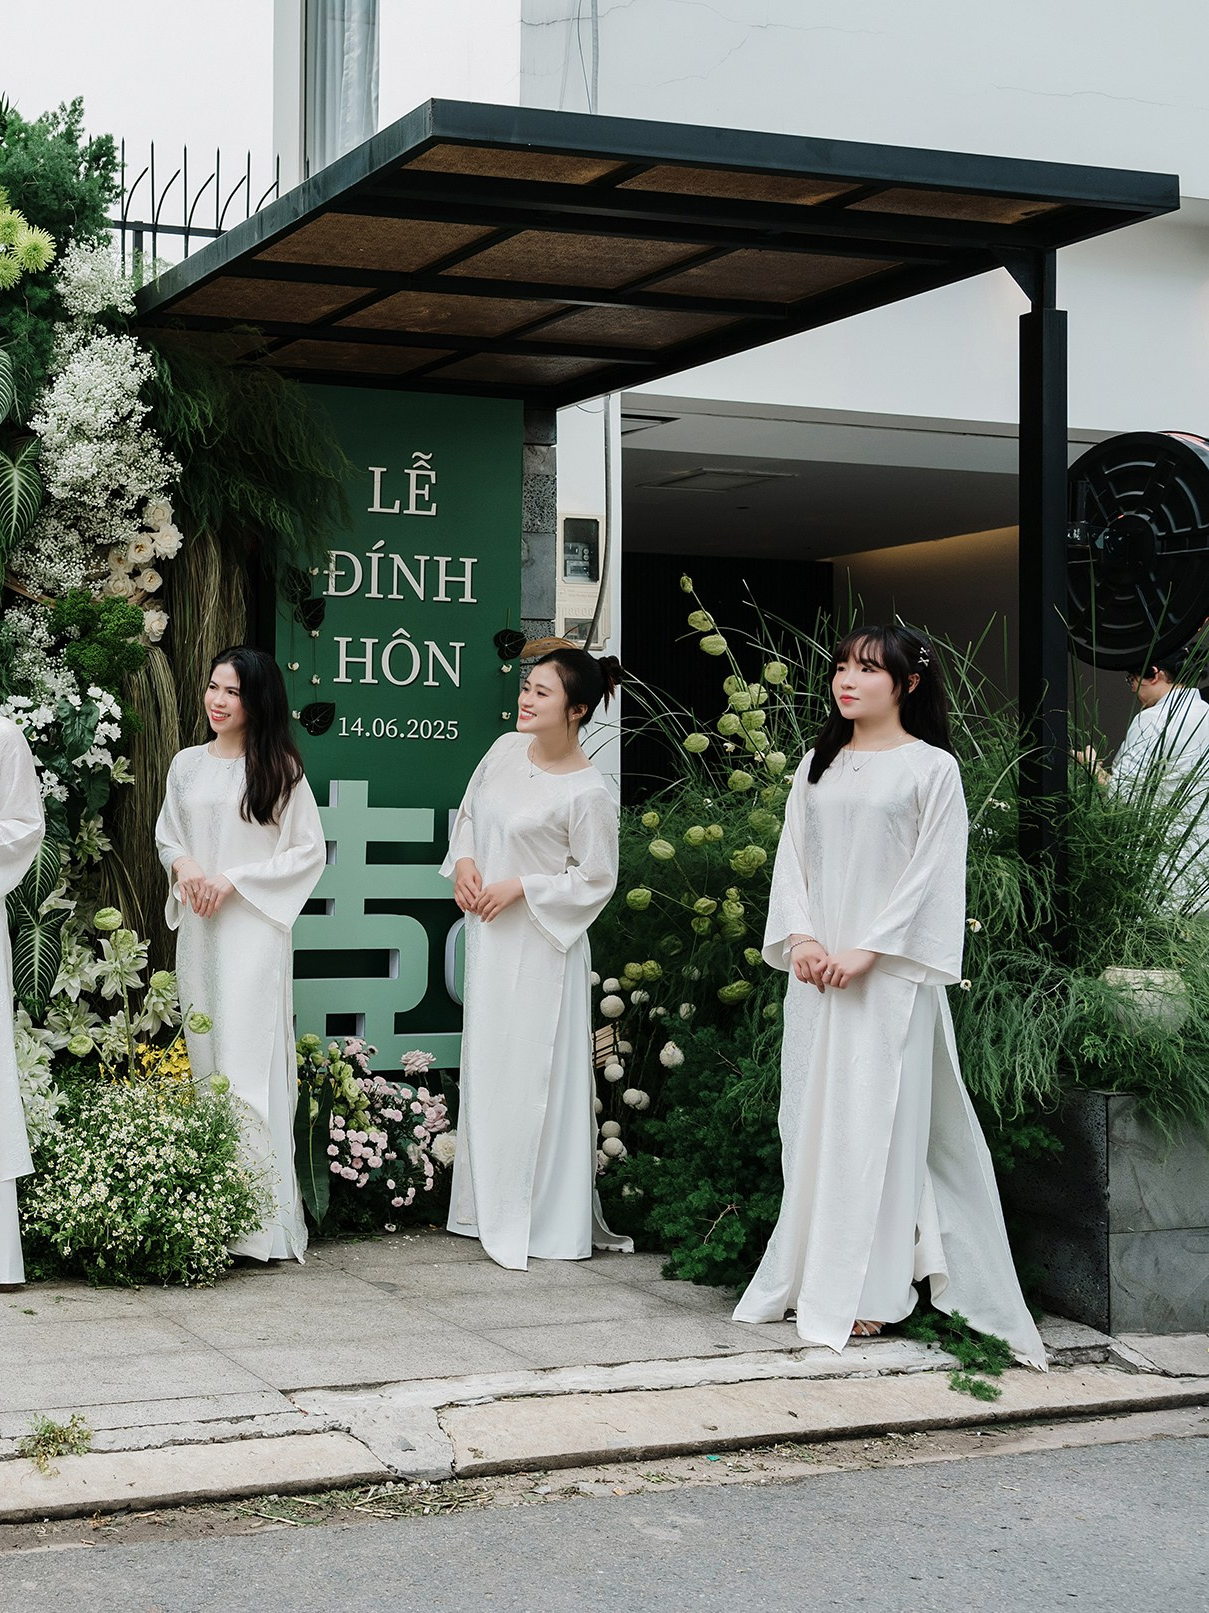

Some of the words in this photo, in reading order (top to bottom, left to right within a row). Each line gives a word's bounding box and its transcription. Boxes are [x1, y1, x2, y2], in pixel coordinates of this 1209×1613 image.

[367, 451, 437, 516] LỄ
[322, 539, 478, 603] ĐÍNH
[333, 627, 466, 688] HÔN
[338, 716, 459, 741] 14.06.2025
